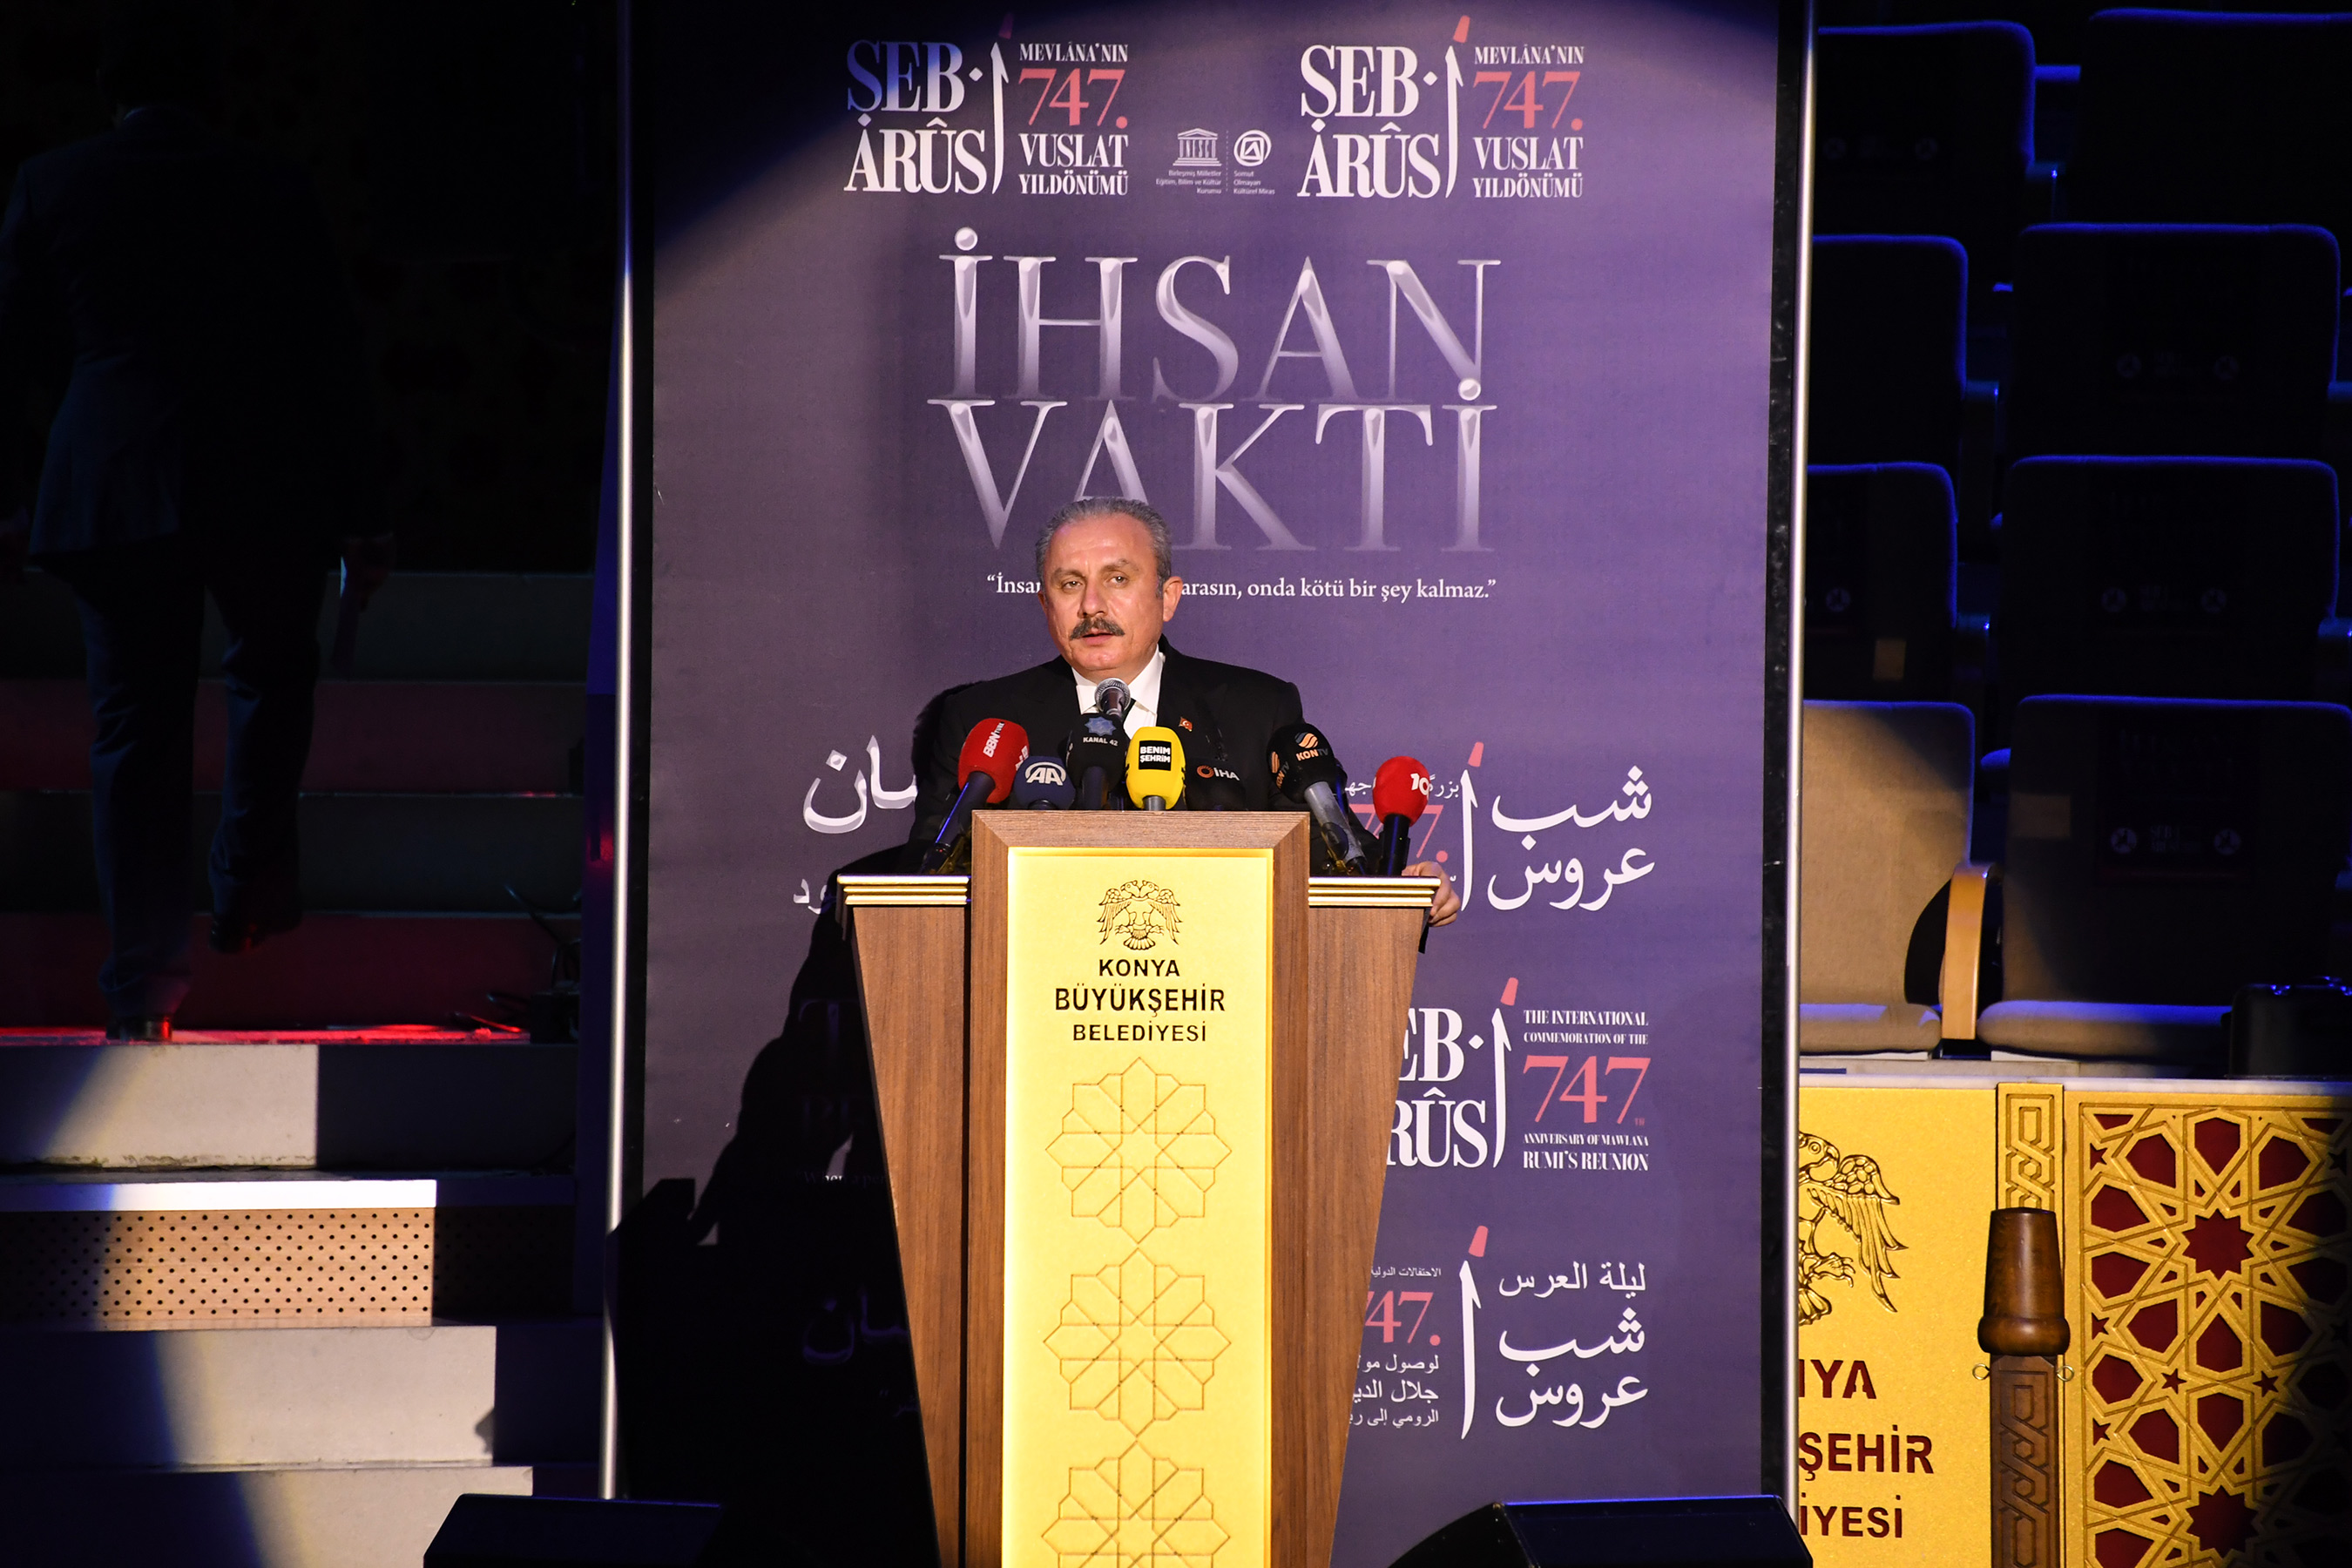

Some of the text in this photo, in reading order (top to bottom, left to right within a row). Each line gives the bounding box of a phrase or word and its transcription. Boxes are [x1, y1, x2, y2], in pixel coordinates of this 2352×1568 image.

[1018, 68, 1128, 126] 747.
[1472, 71, 1584, 131] 747.
[1018, 133, 1129, 167] VUSLAT
[1472, 137, 1584, 171] VUSLAT
[1018, 170, 1129, 196] YILDÖNÜMÜ
[1472, 172, 1584, 199] YILDÖNÜMÜ
[938, 227, 1501, 402] İHSAN
[927, 378, 1498, 552] VAKTİ
[1247, 577, 1296, 597] onda
[1300, 577, 1345, 598] kötü
[1348, 578, 1377, 598] bir
[1381, 585, 1413, 604] şey
[1491, 765, 1652, 851] شب
[1487, 848, 1655, 911] عروس
[1098, 959, 1180, 977] KONYA
[1055, 983, 1226, 1017] BÜYÜKŞEHİR
[1073, 1020, 1206, 1042] BELEDİYESİ
[1524, 1010, 1649, 1026] THE INTERNATIONAL
[1524, 1031, 1649, 1044] COMMEMORATION OF THE
[1523, 1054, 1652, 1125] 747
[1524, 1132, 1649, 1146] ANNIVERSARY OF MAWLANA
[1581, 1152, 1649, 1172] REUNION
[1498, 1260, 1646, 1299] ليلة العرس
[1498, 1307, 1646, 1376] شب
[1385, 1353, 1439, 1375] لوصول
[1390, 1379, 1439, 1404] جلال
[1495, 1375, 1649, 1429] عروس
[1367, 1407, 1388, 1427] إلى
[1392, 1408, 1439, 1429] الرومي
